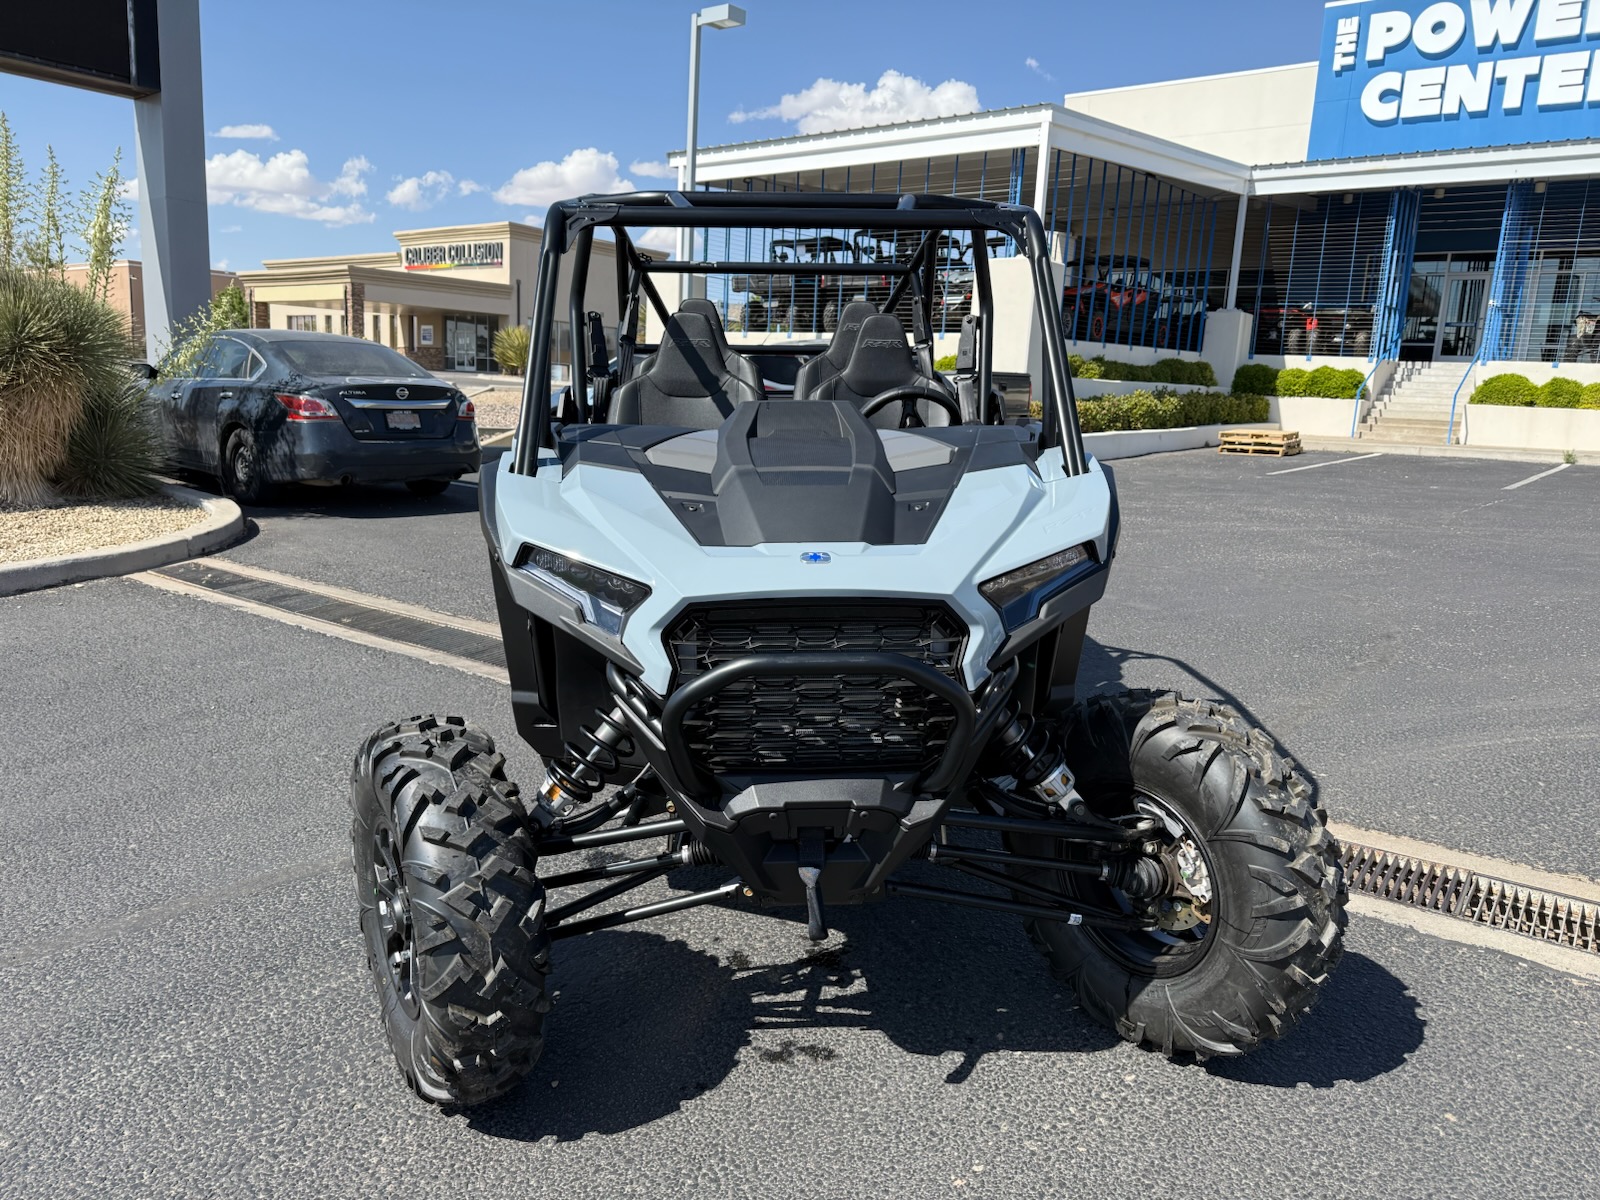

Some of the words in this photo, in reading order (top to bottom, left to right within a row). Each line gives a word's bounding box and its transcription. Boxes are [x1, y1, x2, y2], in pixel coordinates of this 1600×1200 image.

[1332, 15, 1360, 72] THE
[1365, 0, 1600, 62] POWE
[1360, 49, 1600, 122] CENTE
[404, 246, 446, 266] CALIBER
[447, 242, 503, 262] COLLISION
[861, 338, 903, 349] RZR
